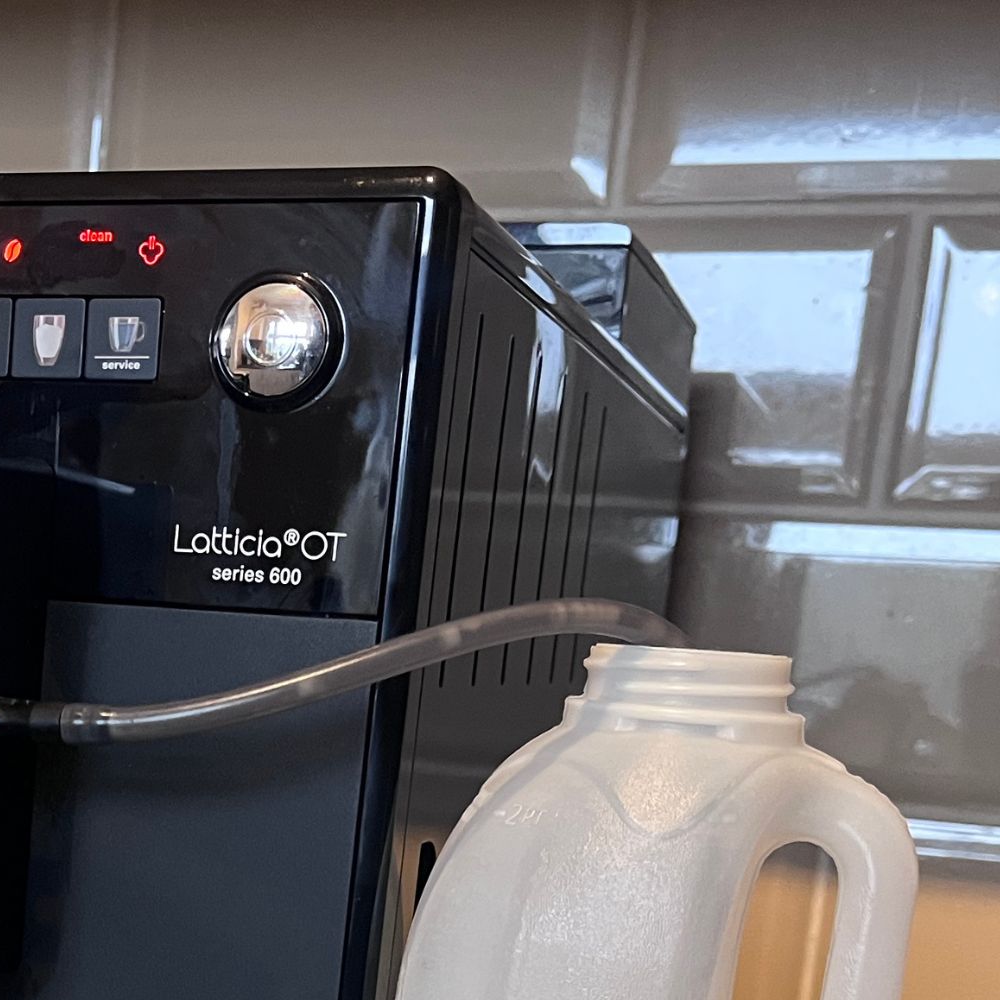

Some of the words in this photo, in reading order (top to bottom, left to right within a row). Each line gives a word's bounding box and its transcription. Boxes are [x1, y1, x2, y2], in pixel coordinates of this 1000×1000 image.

[79, 229, 113, 242] clean
[102, 360, 141, 370] service
[212, 565, 265, 583] series
[269, 567, 302, 585] 600
